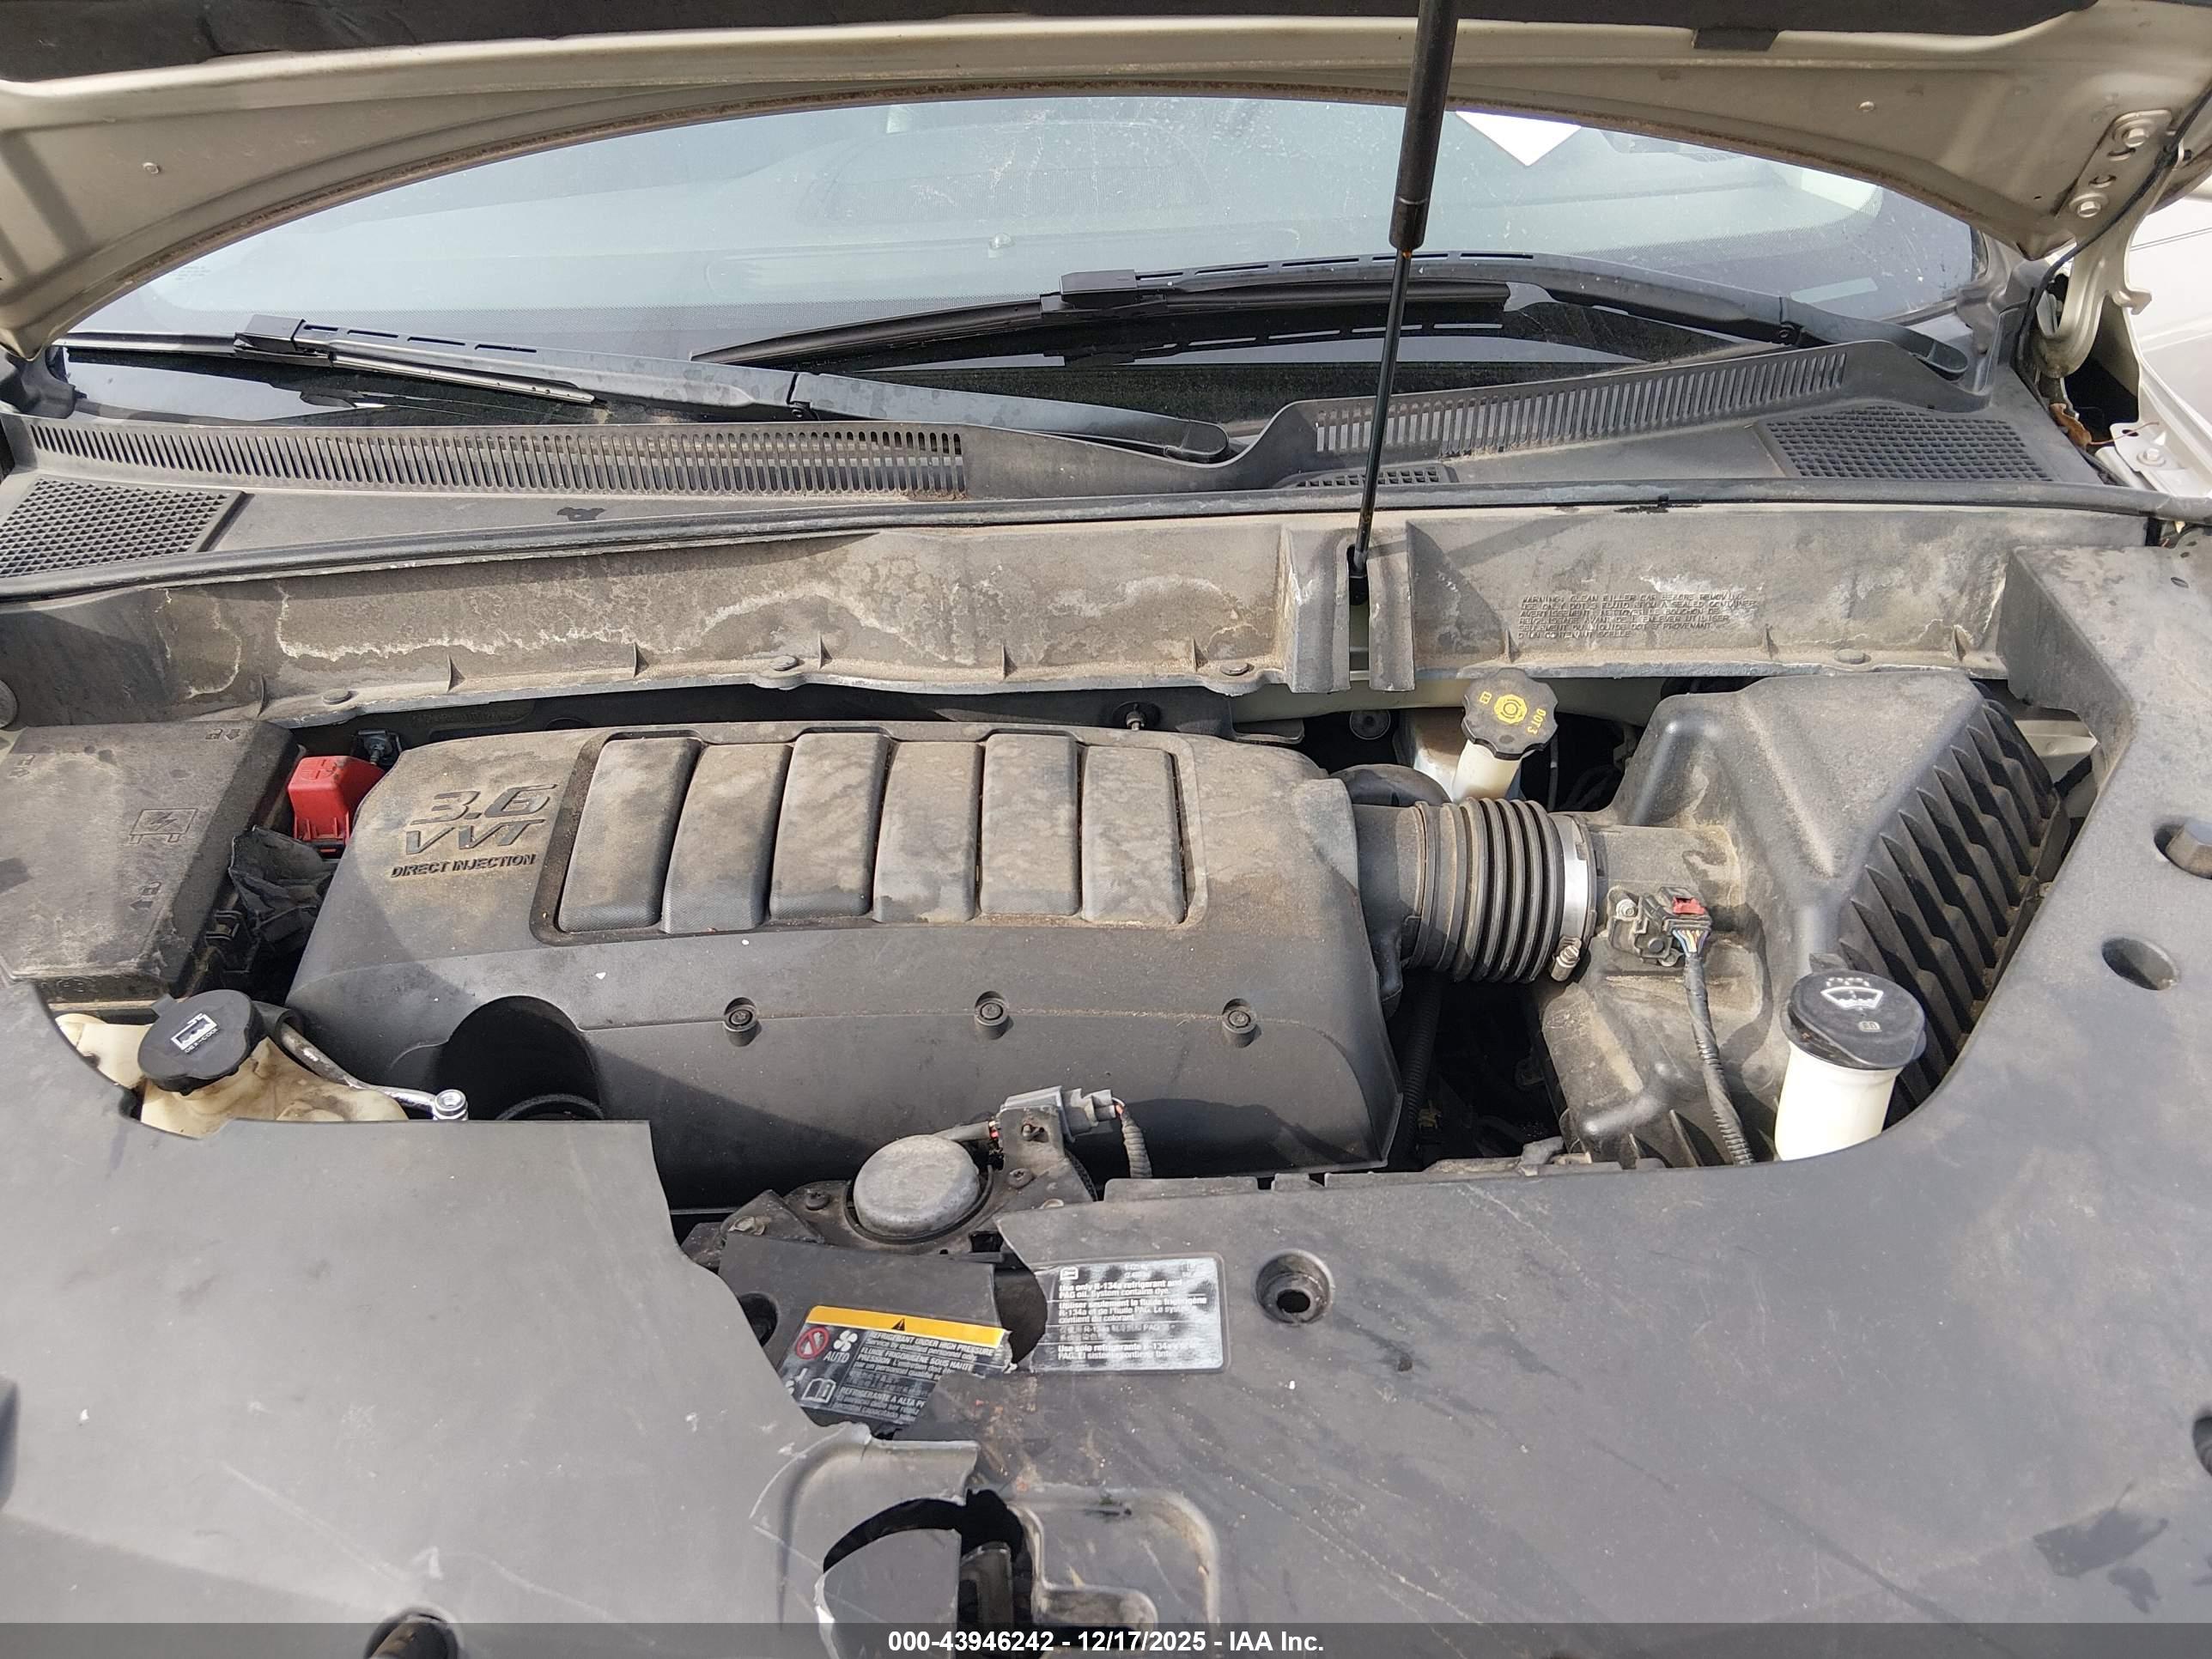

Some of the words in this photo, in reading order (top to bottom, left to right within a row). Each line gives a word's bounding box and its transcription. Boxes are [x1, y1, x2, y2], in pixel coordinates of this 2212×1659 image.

[410, 782, 559, 825] 3.6
[405, 818, 547, 855] VVT
[391, 860, 451, 878] DIRECT
[452, 854, 538, 872] INJECTION
[1059, 1284, 1075, 1292] Use
[1075, 1283, 1093, 1292] only
[1123, 1279, 1167, 1290] refrigerant
[1168, 1279, 1182, 1287] and
[1059, 1291, 1076, 1299] PAG
[1121, 1288, 1153, 1297] contains
[1088, 1299, 1130, 1308] seulement
[1058, 1316, 1090, 1324] contient
[868, 1331, 915, 1346] REFRIGERANT
[915, 1337, 939, 1348] UNDER
[939, 1340, 957, 1351] HIGH
[957, 1342, 995, 1357] PRESSURE
[823, 1350, 851, 1364] AUTO
[927, 1347, 962, 1360] personnel
